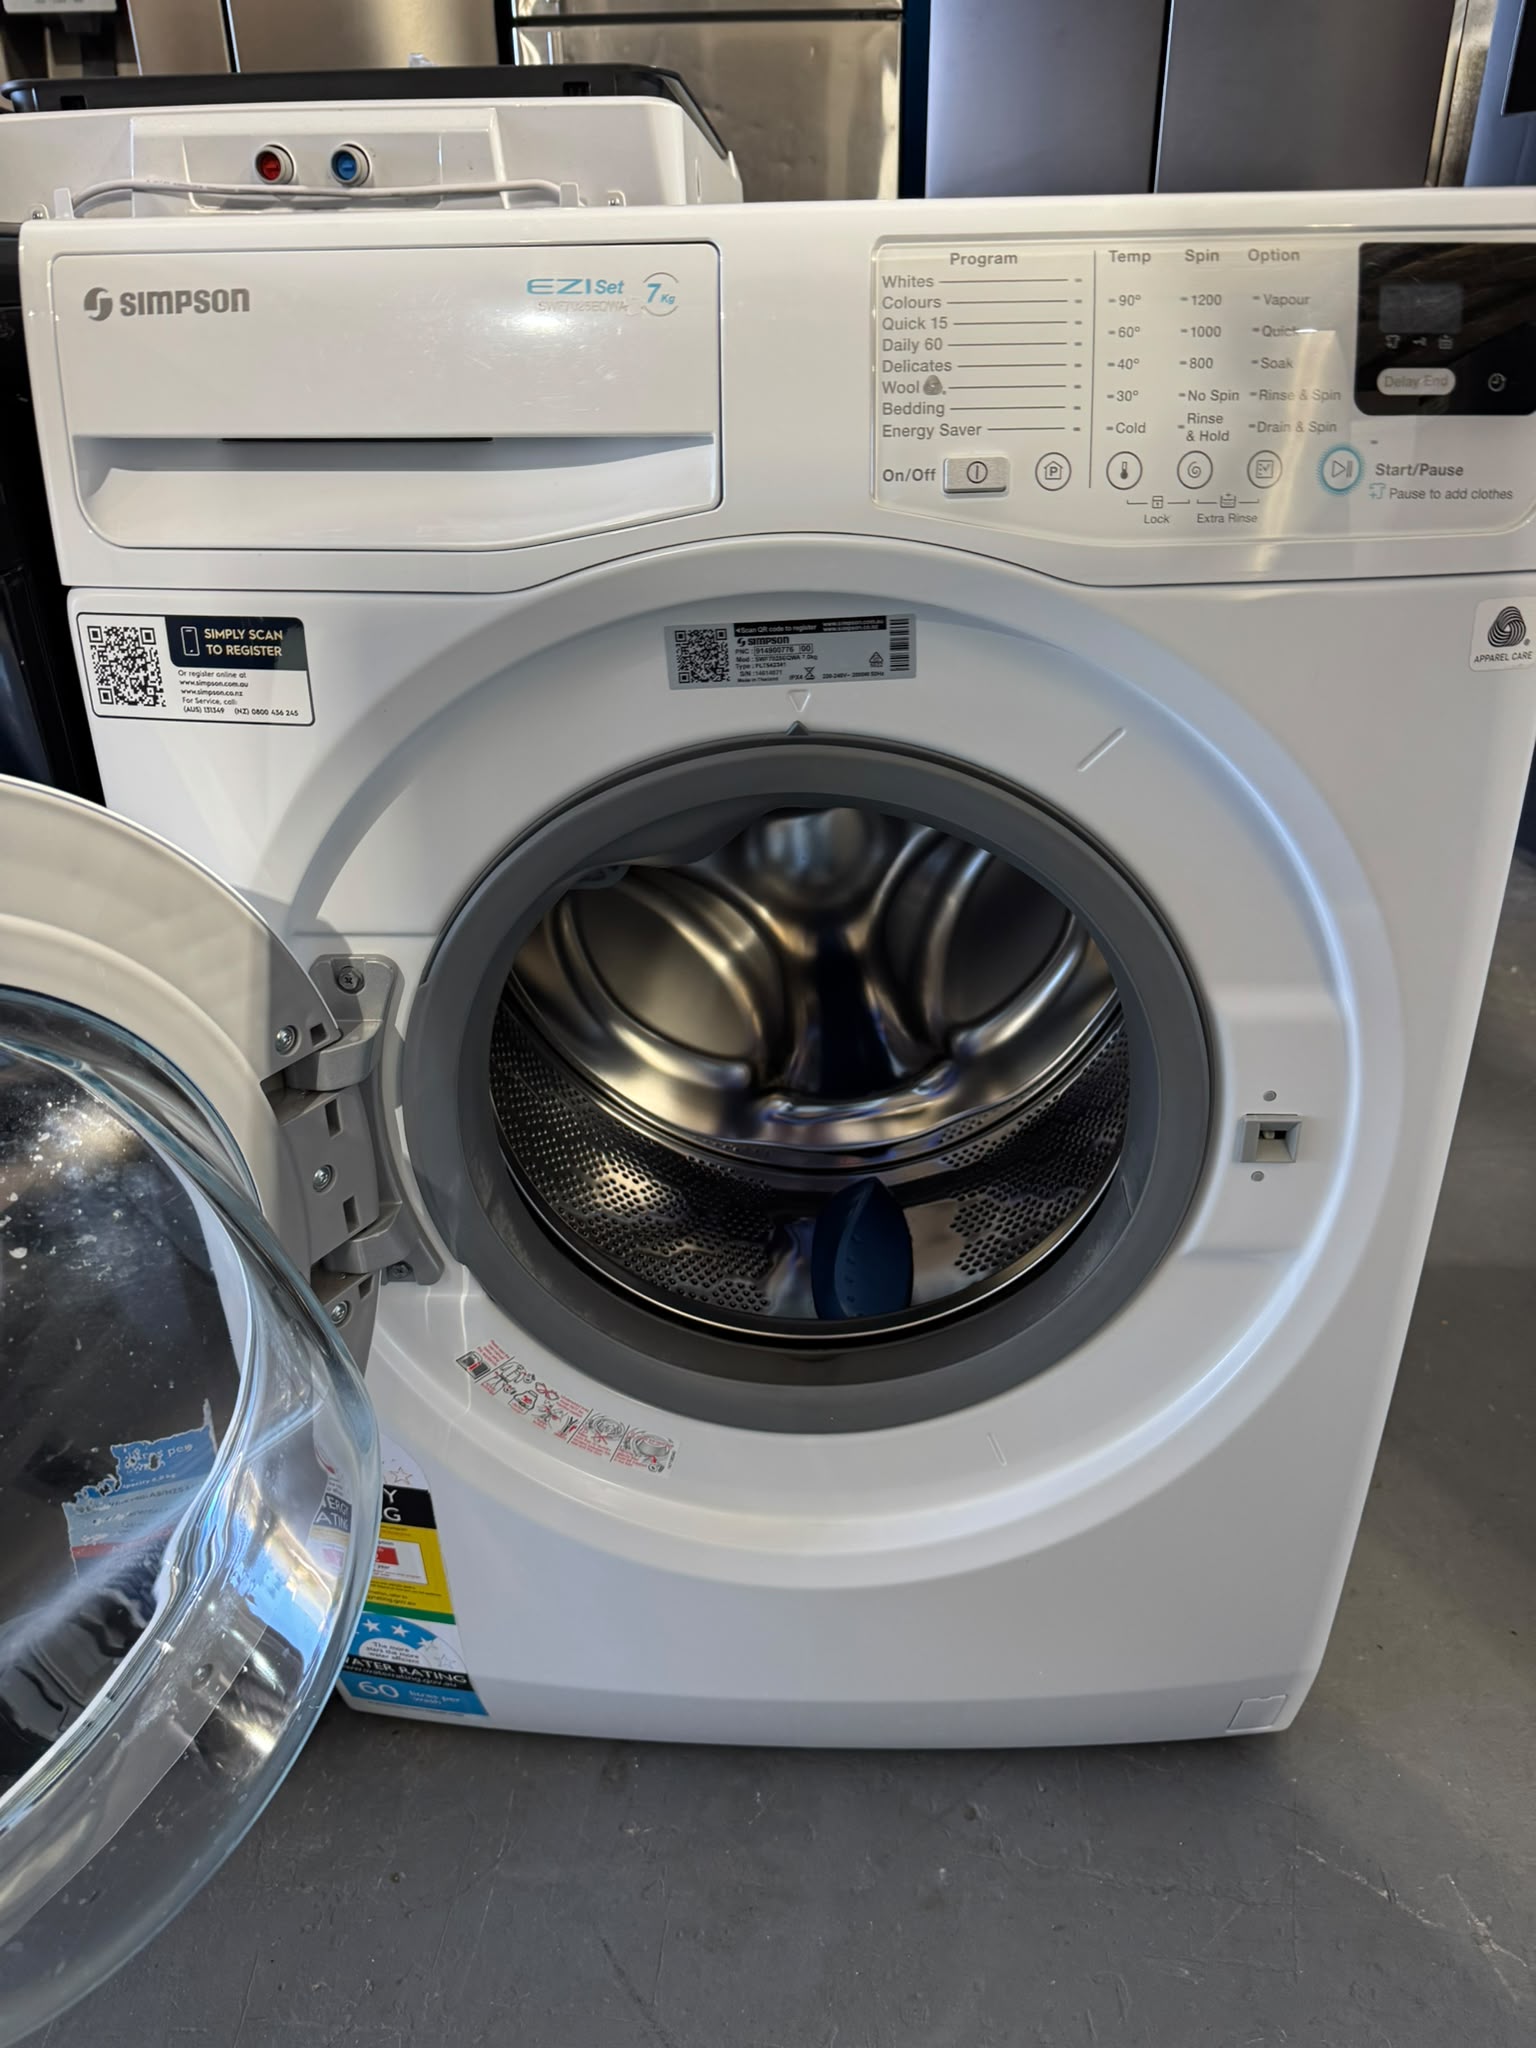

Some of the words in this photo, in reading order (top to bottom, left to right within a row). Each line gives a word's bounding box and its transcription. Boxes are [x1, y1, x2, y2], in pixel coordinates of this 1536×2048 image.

[950, 252, 1018, 267] Program
[1108, 250, 1151, 264] Temp
[1184, 249, 1220, 263] Spin
[1248, 248, 1300, 262] Option
[594, 279, 625, 295] Set
[882, 275, 934, 288] Whites
[882, 297, 941, 309] Colours
[1191, 294, 1222, 306] 1200
[1263, 294, 1311, 307] Vapour
[882, 317, 925, 331] Quick
[931, 317, 948, 329] 15
[1190, 326, 1222, 338] 1000
[882, 338, 919, 354] Daily
[924, 337, 943, 350] 60
[882, 359, 952, 373] Delicates
[1189, 357, 1214, 370] 800
[1260, 357, 1293, 369] Soak
[882, 380, 920, 394] Wool
[1384, 375, 1419, 390] Delay
[1424, 375, 1449, 387] End
[1187, 389, 1207, 402] No
[1210, 389, 1240, 403] Spin
[1259, 388, 1295, 401] Rinse
[1300, 389, 1308, 401] &
[1312, 389, 1341, 403] Spin
[882, 402, 945, 417] Bedding
[1187, 412, 1223, 425] Rinse
[882, 425, 934, 440] Energy
[939, 423, 982, 437] Saver
[1115, 422, 1146, 434] Cold
[1257, 421, 1291, 434] Drain
[1295, 421, 1305, 433] &
[1308, 421, 1337, 435] Spin
[1186, 430, 1196, 442] &
[1200, 430, 1229, 442] Hold
[882, 467, 936, 482] On/Off
[1375, 463, 1464, 477] Start/Pause
[1389, 488, 1425, 500] Pause
[1429, 489, 1441, 499] to
[1445, 488, 1467, 499] add
[1470, 488, 1513, 499] clothes
[1144, 513, 1170, 524] Lock
[1197, 513, 1224, 524] Extra
[1228, 512, 1258, 524] Rinse
[204, 628, 245, 639] SIMPLY
[249, 629, 283, 640] SCAN
[206, 644, 223, 655] TO
[226, 645, 282, 657] REGISTER
[1473, 653, 1509, 663] APPAREL
[1511, 651, 1533, 660] CARE
[179, 679, 249, 688] www.simpson.com.au
[181, 688, 243, 697] www.simpson.co.nz
[183, 706, 202, 714] (AUS)
[251, 708, 269, 716] 0800
[373, 1641, 388, 1650] The
[389, 1645, 410, 1653] more
[398, 1665, 468, 1683] RATING
[359, 1681, 399, 1699] 60
